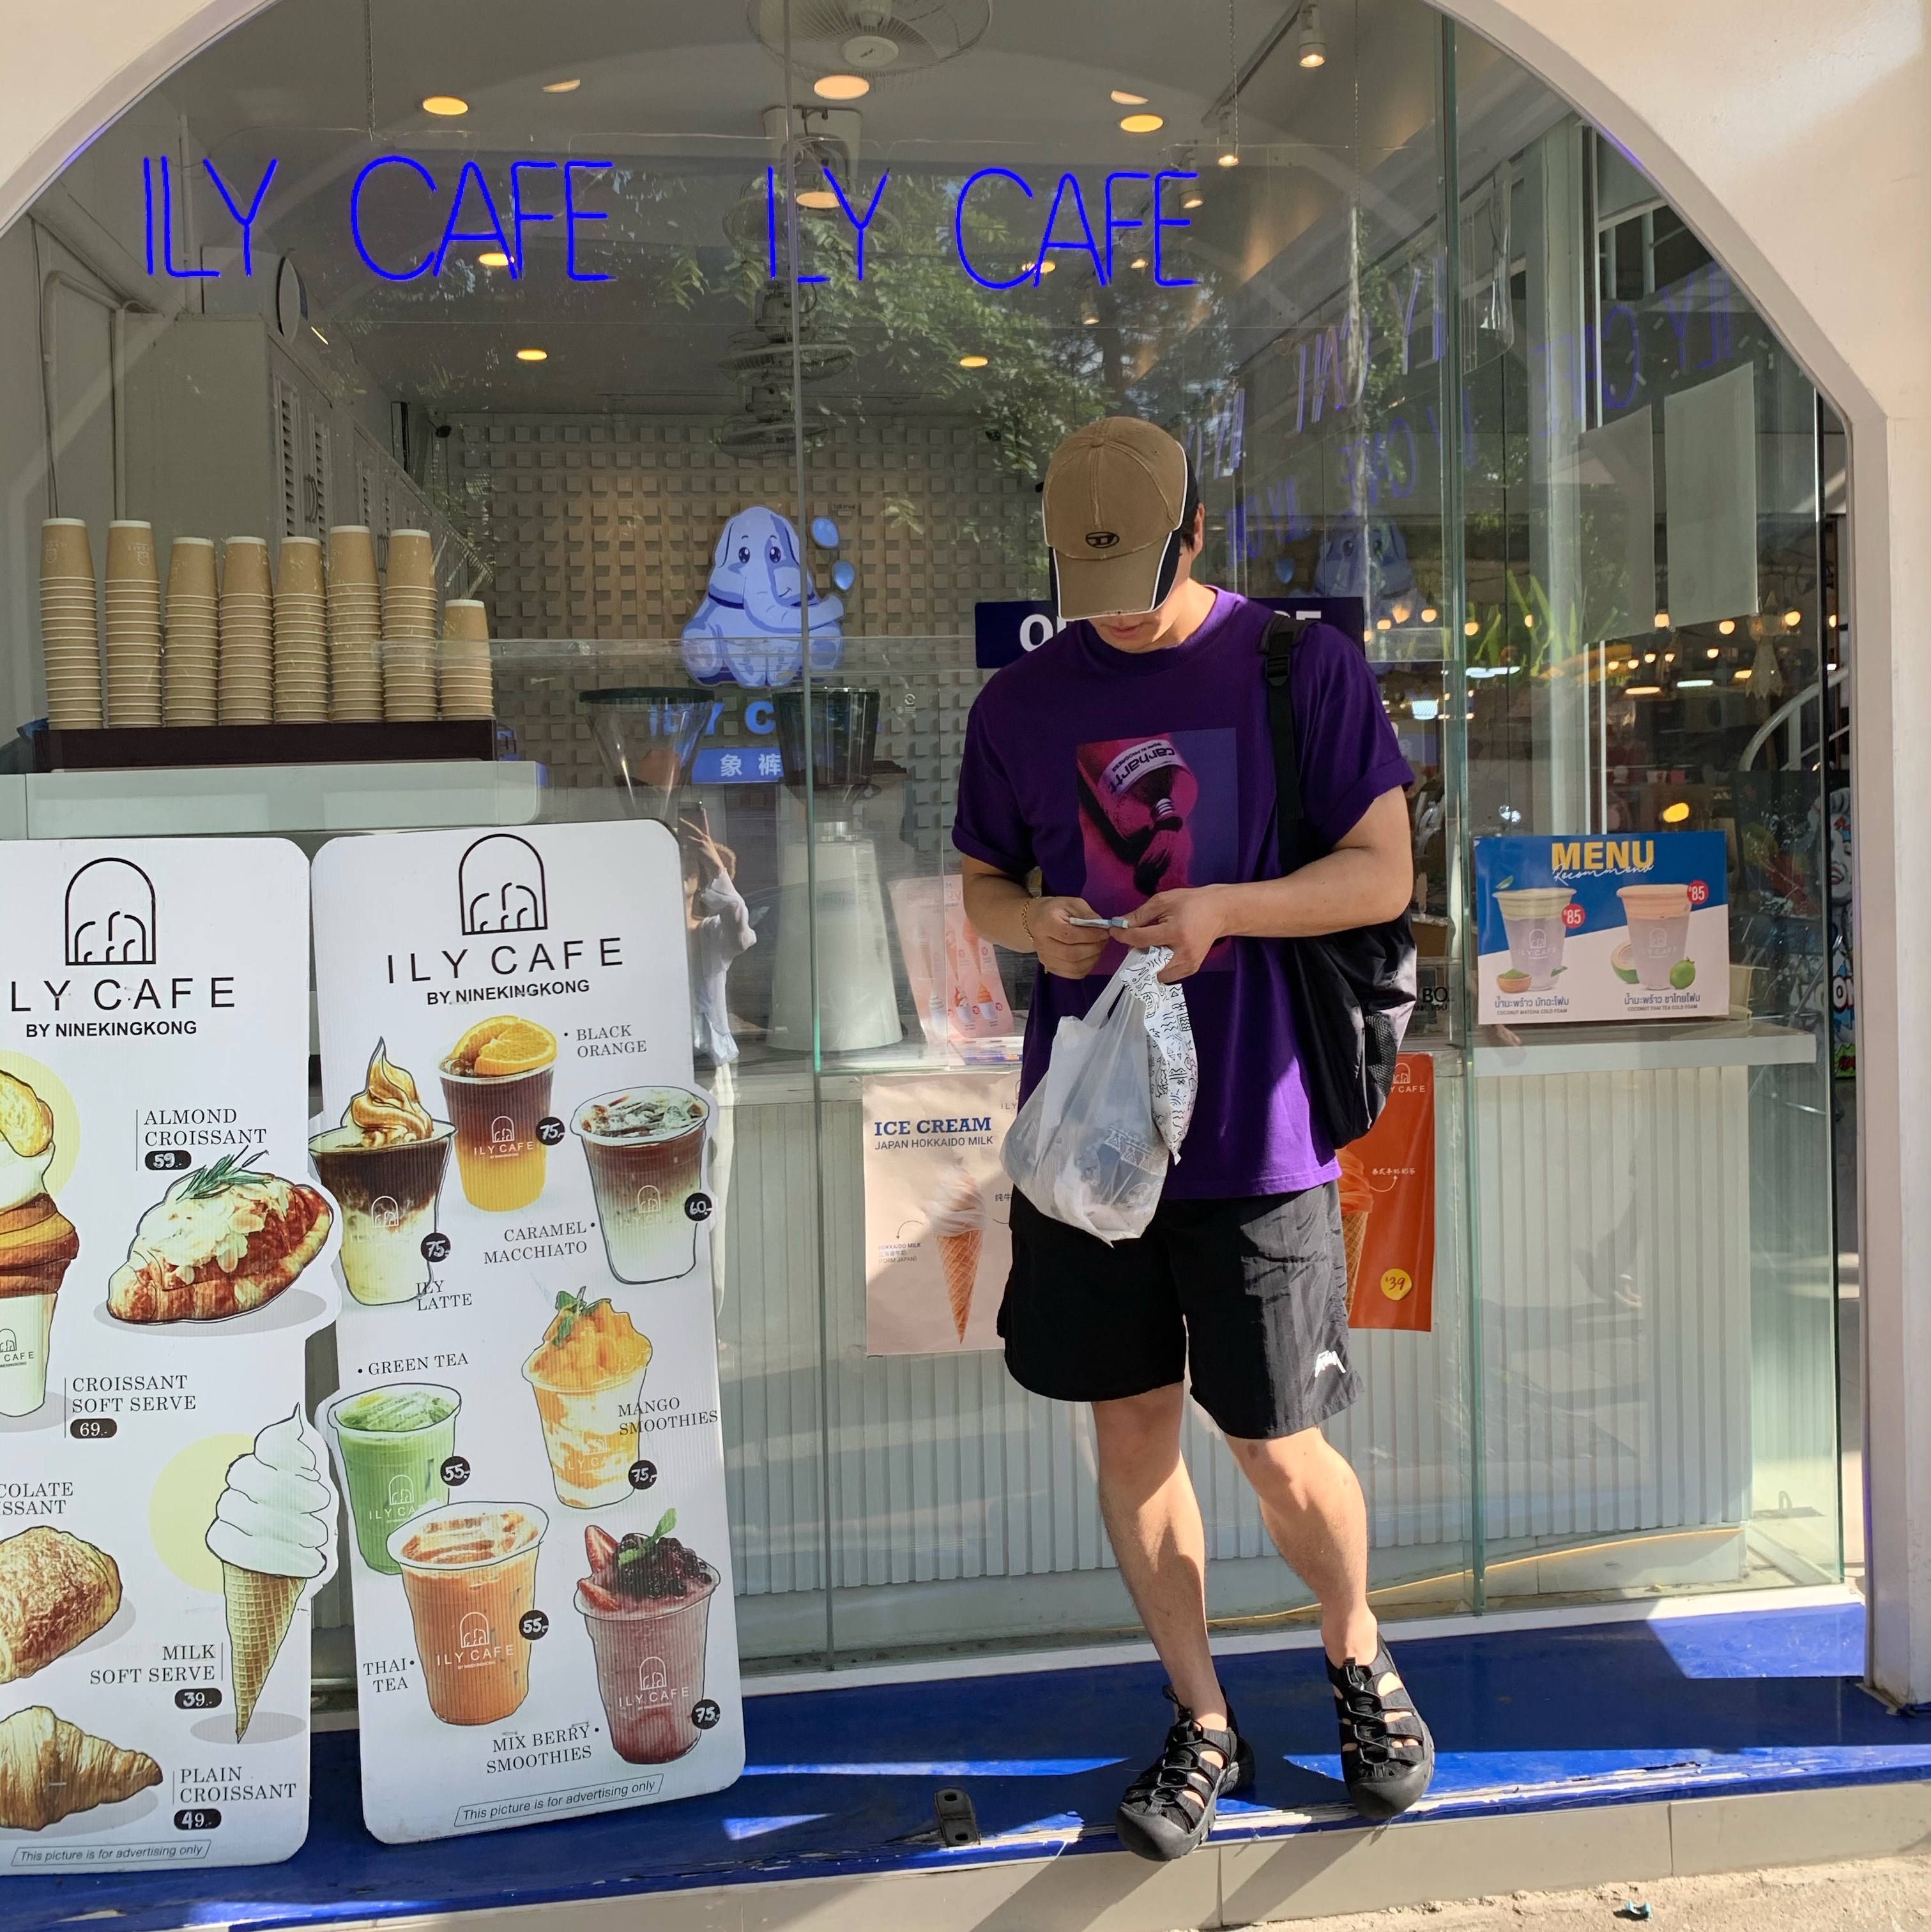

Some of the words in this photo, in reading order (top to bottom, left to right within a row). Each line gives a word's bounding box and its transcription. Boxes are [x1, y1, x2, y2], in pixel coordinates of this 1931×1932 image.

[144, 156, 277, 277] ILY
[351, 155, 615, 282] CAFE
[768, 165, 889, 283] IY
[956, 167, 1198, 289] CAFE
[1551, 840, 1654, 871] MENU
[1552, 863, 1654, 886] Recommend
[388, 948, 468, 984] ILY
[491, 937, 623, 975] CAFE
[94, 977, 235, 1010] CAFE
[427, 991, 450, 1005] BY
[455, 979, 590, 1003] NINEKINGKONG
[26, 1023, 50, 1038] BY
[56, 1021, 197, 1037] NINEKINGKONG
[577, 1024, 632, 1042] BLACK
[577, 1040, 647, 1058] ORANGE
[144, 1108, 238, 1126] ALMOND
[874, 1120, 910, 1136] ICE
[916, 1116, 992, 1134] CREAM
[144, 1128, 267, 1147] CROISSANT
[874, 1139, 908, 1150] JAPAN
[912, 1137, 965, 1148] HOKKAIDO
[968, 1135, 993, 1146] MILK
[474, 1145, 495, 1155] ILY
[500, 1141, 533, 1153] CAFE
[504, 1222, 587, 1242] CARAMEL
[484, 1240, 588, 1265] MACCHIATO
[417, 1293, 473, 1311] LATTE
[4, 1351, 34, 1362] CAFE
[368, 1357, 429, 1376] GREEN
[434, 1352, 469, 1368] TEA
[72, 1374, 188, 1393] CROISSANT
[72, 1398, 123, 1414] SOFT
[130, 1396, 196, 1412] SERVE
[618, 1397, 680, 1417] MANGO
[619, 1410, 719, 1436] SMOOTHIES
[0, 1500, 66, 1516] SSANT
[369, 1508, 392, 1520] ILY
[397, 1505, 424, 1517] CA
[162, 1643, 216, 1661] MILK
[437, 1652, 464, 1666] ILY
[470, 1645, 515, 1661] CAFE
[90, 1669, 141, 1685] SOFT
[149, 1666, 216, 1683] SERVE
[363, 1658, 408, 1677] THAI
[373, 1676, 409, 1693] TEA
[619, 1694, 643, 1708] ILY
[649, 1687, 690, 1703] CAFE
[492, 1734, 526, 1753] MIX
[532, 1725, 590, 1747] BERRY
[486, 1746, 592, 1774] SMOOTHIES
[179, 1766, 242, 1783] PLAIN
[179, 1783, 297, 1803] CROISSANT
[463, 1809, 487, 1821] This
[490, 1804, 531, 1820] picture
[534, 1800, 544, 1810] is
[546, 1796, 563, 1808] for
[566, 1784, 629, 1804] advertising
[632, 1779, 656, 1795] only
[21, 1850, 42, 1862] This
[45, 1850, 83, 1863] picture
[86, 1850, 95, 1859] is
[98, 1849, 114, 1859] for
[116, 1846, 177, 1860] advertising
[179, 1845, 203, 1857] only
